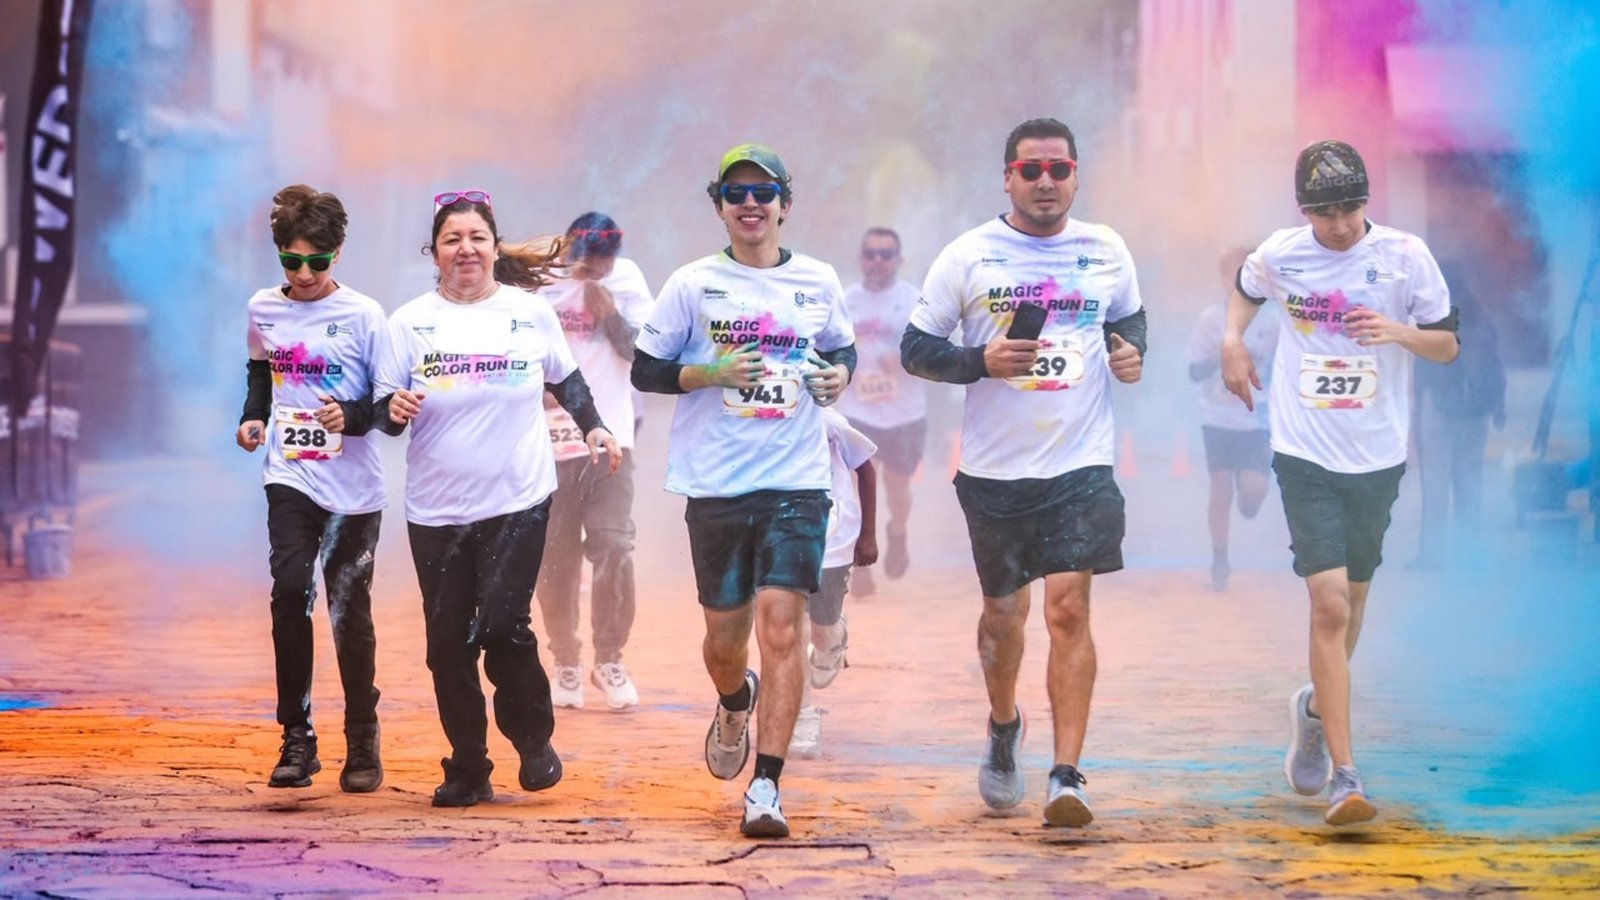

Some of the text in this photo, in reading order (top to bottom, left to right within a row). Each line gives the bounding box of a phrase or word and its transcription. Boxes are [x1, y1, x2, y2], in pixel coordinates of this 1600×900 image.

[988, 286, 1043, 300] MAGIC
[1047, 299, 1081, 312] RUN
[1286, 294, 1330, 308] MAGIC
[1288, 307, 1329, 322] COLOR
[710, 320, 760, 332] MAGIC
[712, 333, 759, 344] COLOR
[761, 335, 794, 347] RUN
[296, 363, 323, 375] RUN
[424, 363, 471, 379] COLOR
[475, 360, 507, 373] RUN
[1030, 356, 1067, 377] 39
[1315, 375, 1362, 395] 237
[738, 385, 785, 404] 941
[283, 427, 327, 448] 238
